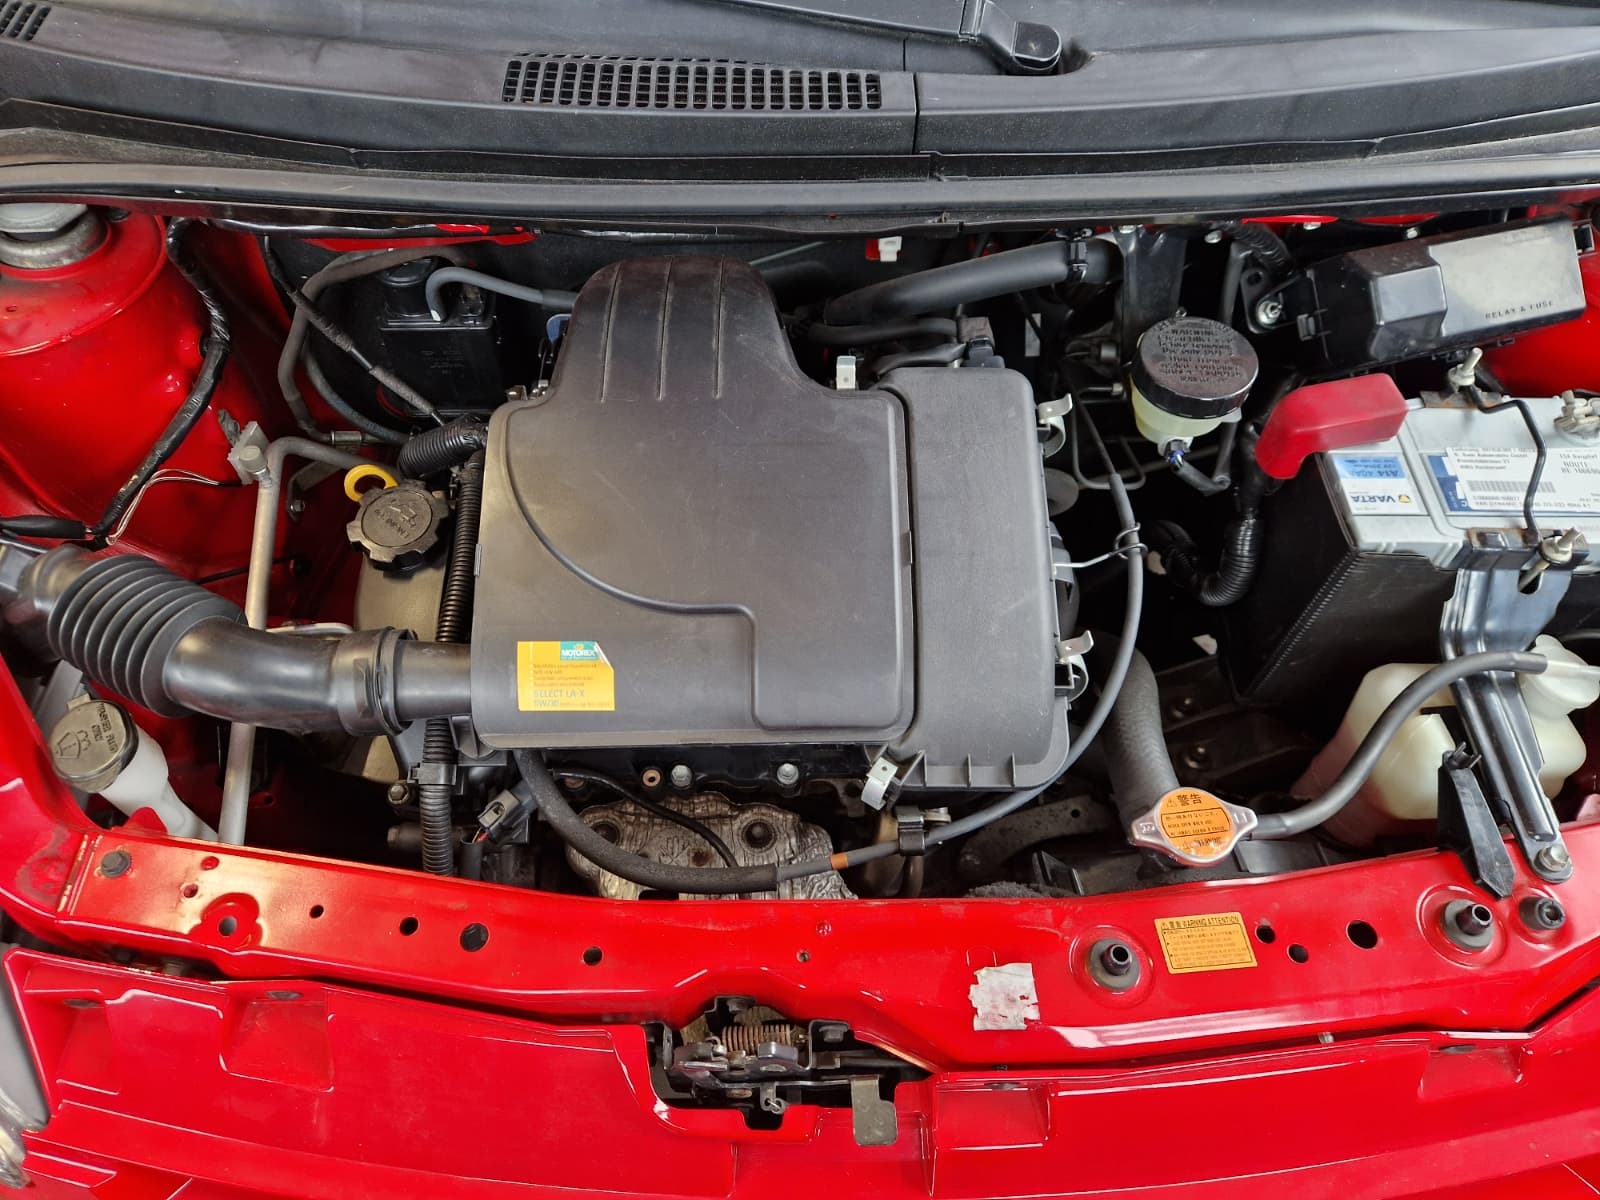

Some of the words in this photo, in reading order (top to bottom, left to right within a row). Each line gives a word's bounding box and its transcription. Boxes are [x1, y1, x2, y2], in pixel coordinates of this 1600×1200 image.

[1485, 307, 1516, 319] RELAY
[1350, 495, 1397, 503] VARTA
[561, 649, 596, 657] MOTOREX
[534, 688, 563, 698] SELECT
[96, 702, 112, 732] WASHER
[1176, 793, 1202, 807] 警告
[1208, 915, 1240, 925] ATTENTION
